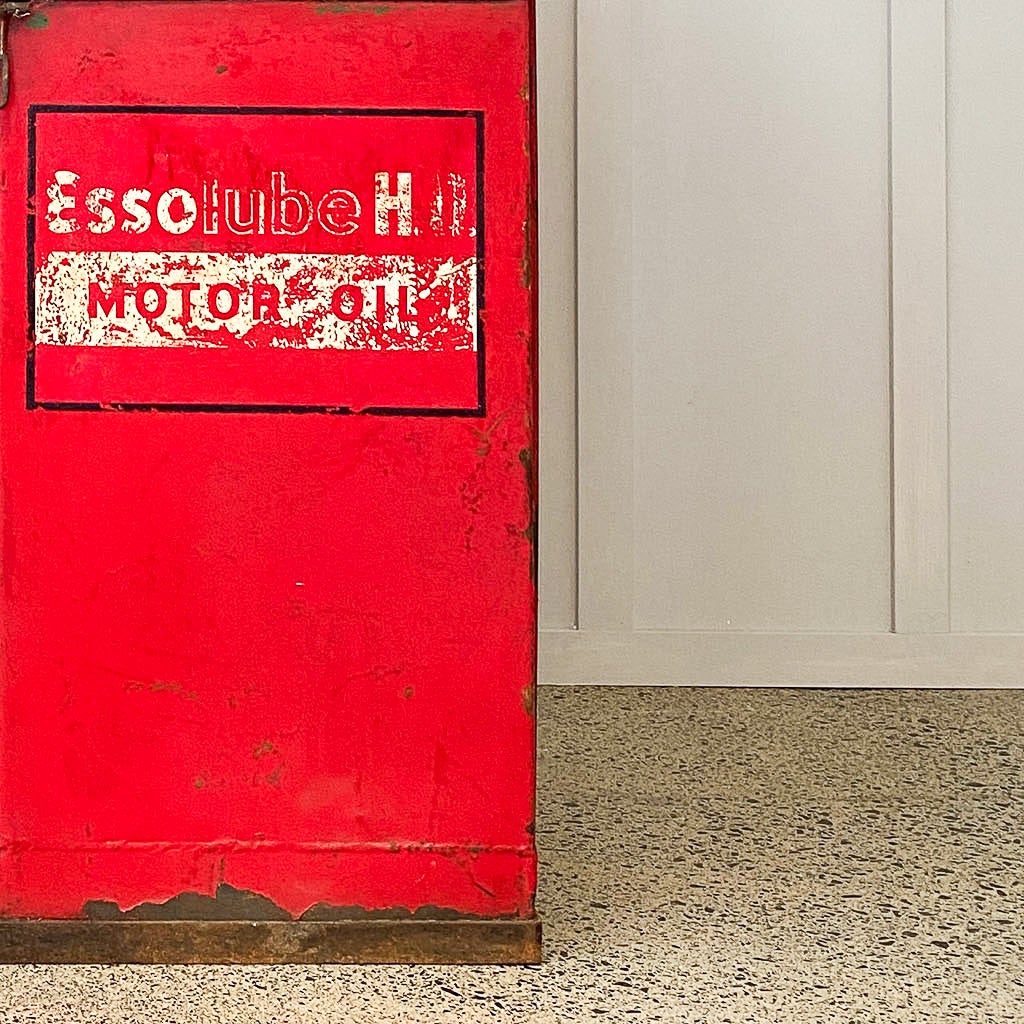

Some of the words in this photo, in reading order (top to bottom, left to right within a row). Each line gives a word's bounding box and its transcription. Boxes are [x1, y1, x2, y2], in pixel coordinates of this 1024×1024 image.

[45, 170, 362, 236] Essolube
[87, 281, 282, 322] MOTOR
[330, 284, 420, 323] OIL
